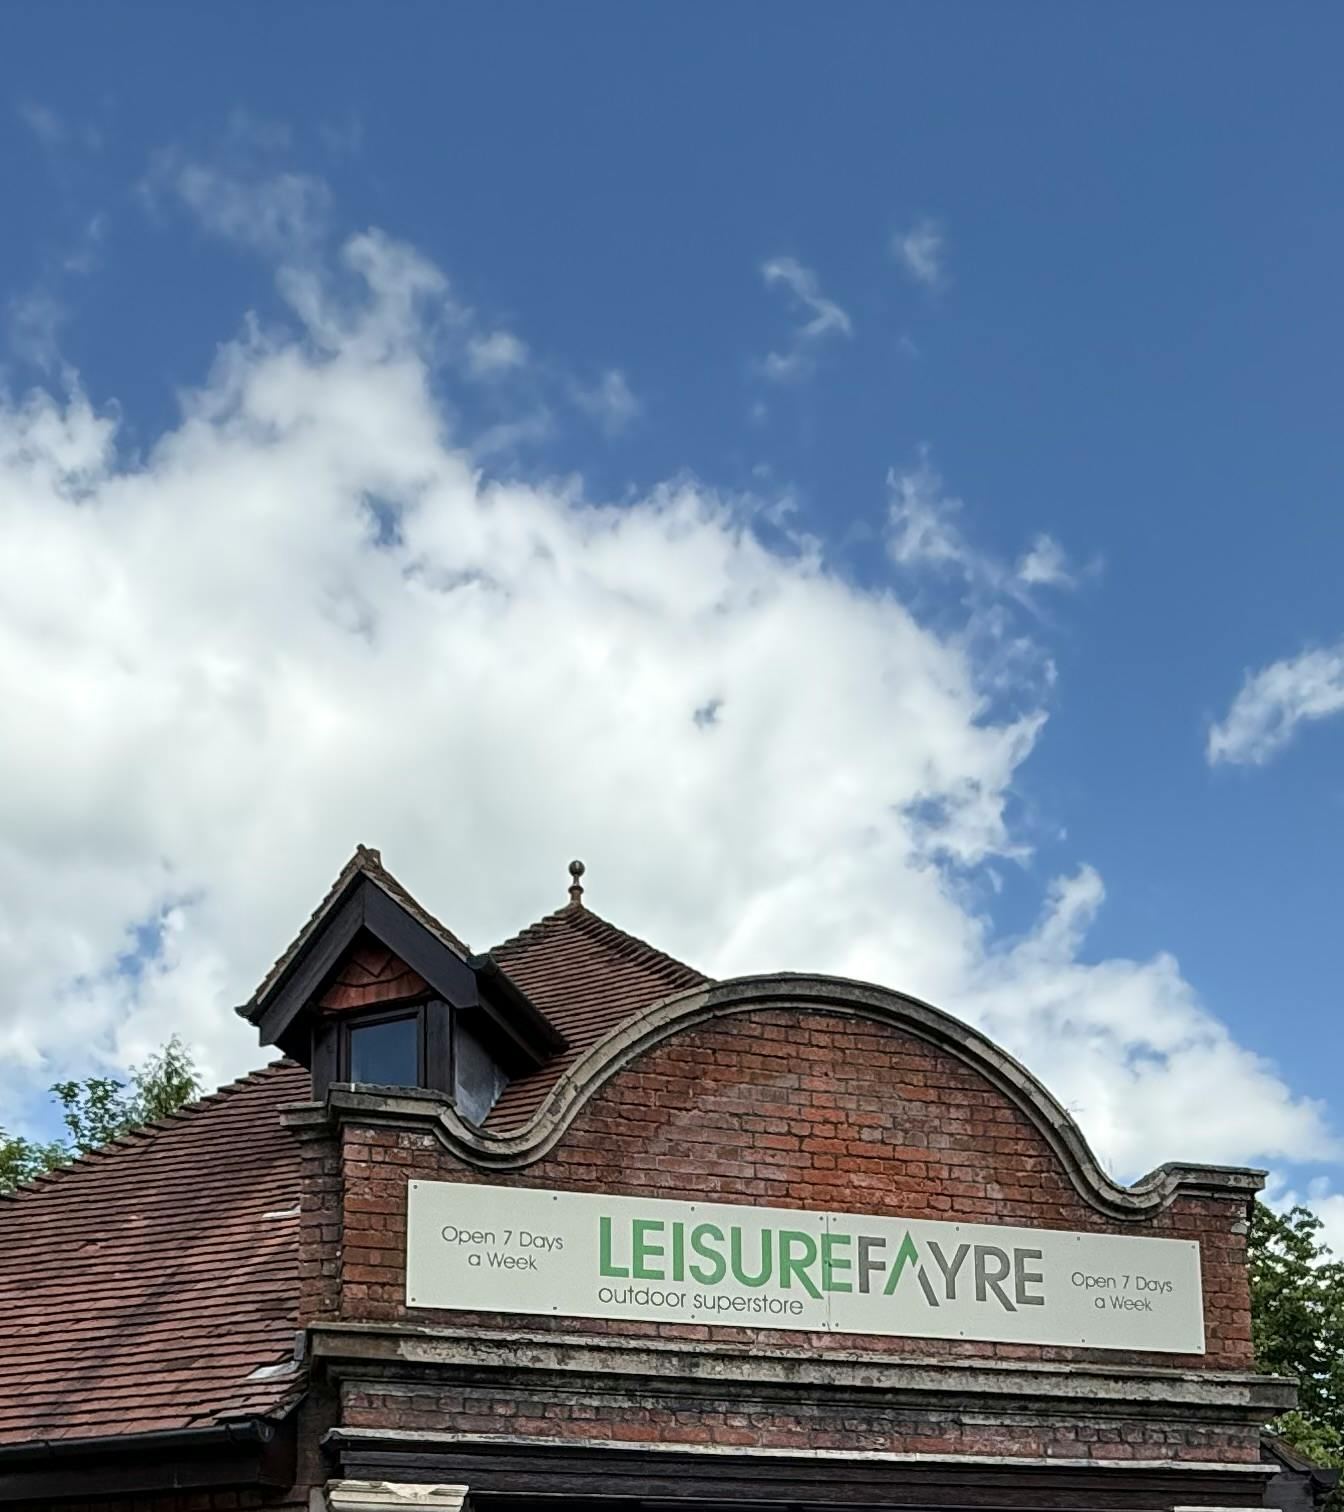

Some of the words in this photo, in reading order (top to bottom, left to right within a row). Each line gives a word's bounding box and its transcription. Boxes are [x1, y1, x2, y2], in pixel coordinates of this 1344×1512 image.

[441, 1225, 496, 1246] Open
[503, 1230, 513, 1245] 7
[519, 1231, 564, 1251] Days
[468, 1253, 481, 1267] a
[486, 1251, 538, 1271] Week
[1071, 1271, 1116, 1290] Open
[1122, 1274, 1130, 1290] 7
[1136, 1276, 1173, 1294] Days
[598, 1286, 687, 1309] outdoor
[693, 1291, 804, 1315] superstore
[1094, 1296, 1106, 1310] a
[1111, 1295, 1153, 1312] Week
